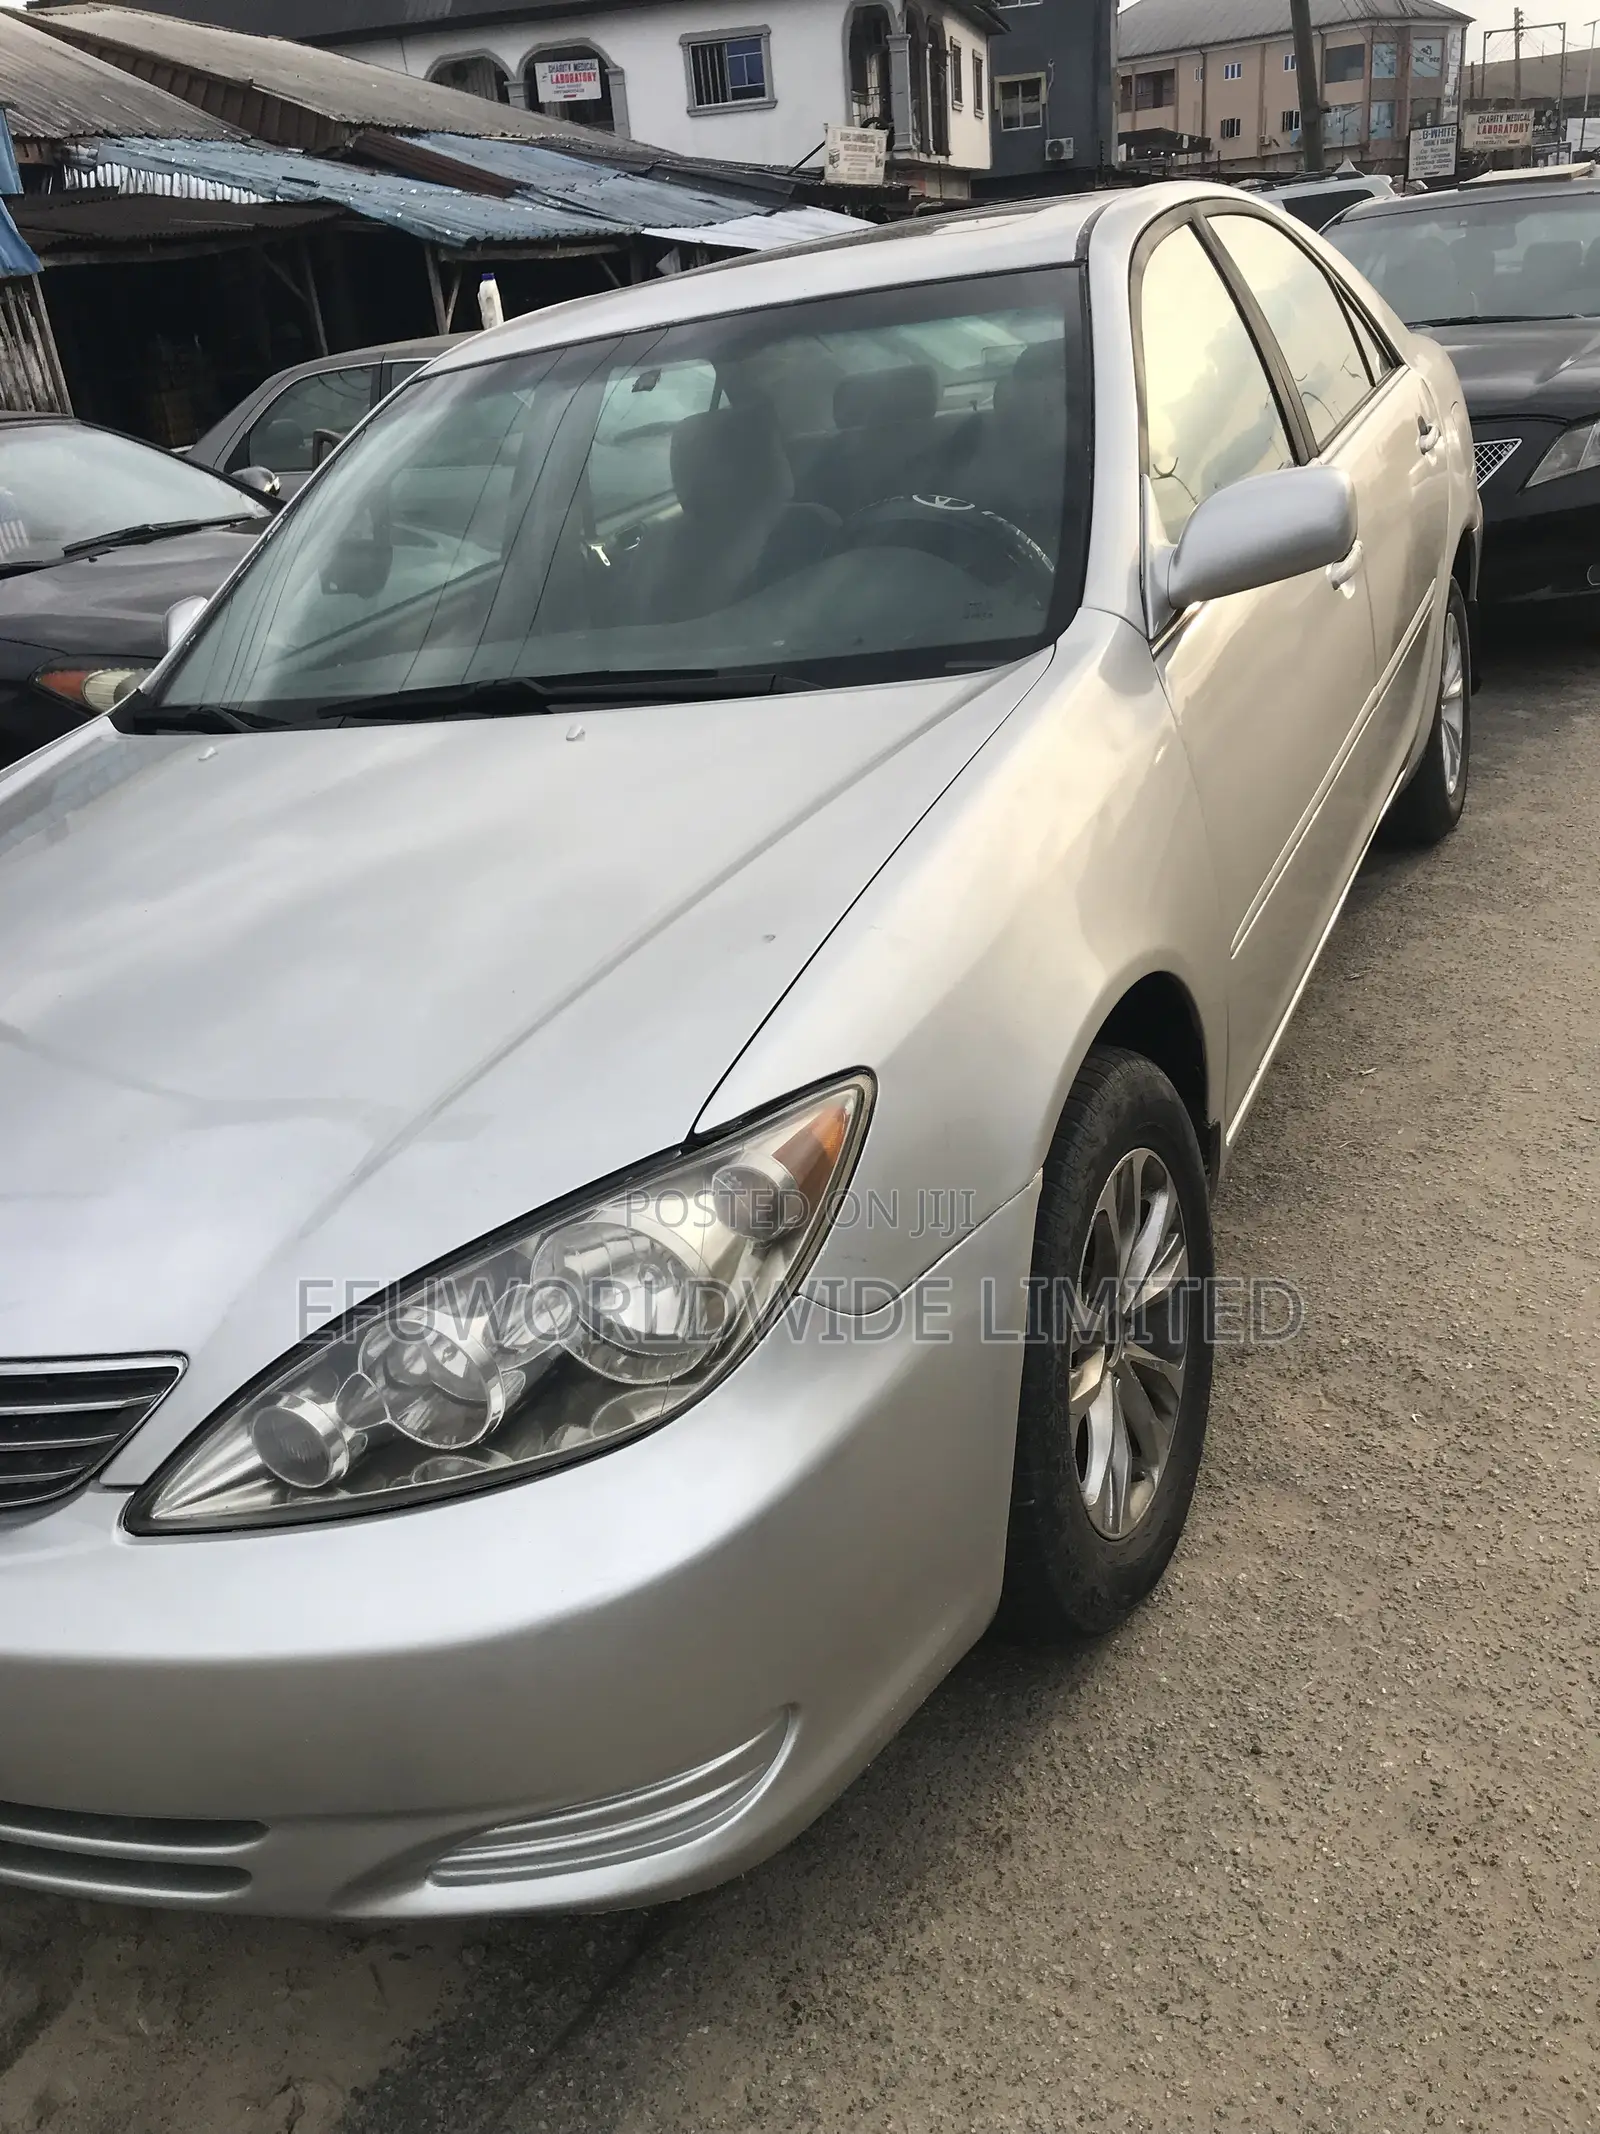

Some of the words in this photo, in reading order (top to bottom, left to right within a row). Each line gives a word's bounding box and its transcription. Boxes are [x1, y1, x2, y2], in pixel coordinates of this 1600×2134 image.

[551, 72, 597, 84] LABORATORY
[1478, 115, 1503, 124] CHARITY
[1506, 113, 1530, 122] MEDICAL
[1477, 123, 1530, 135] LABORATORY
